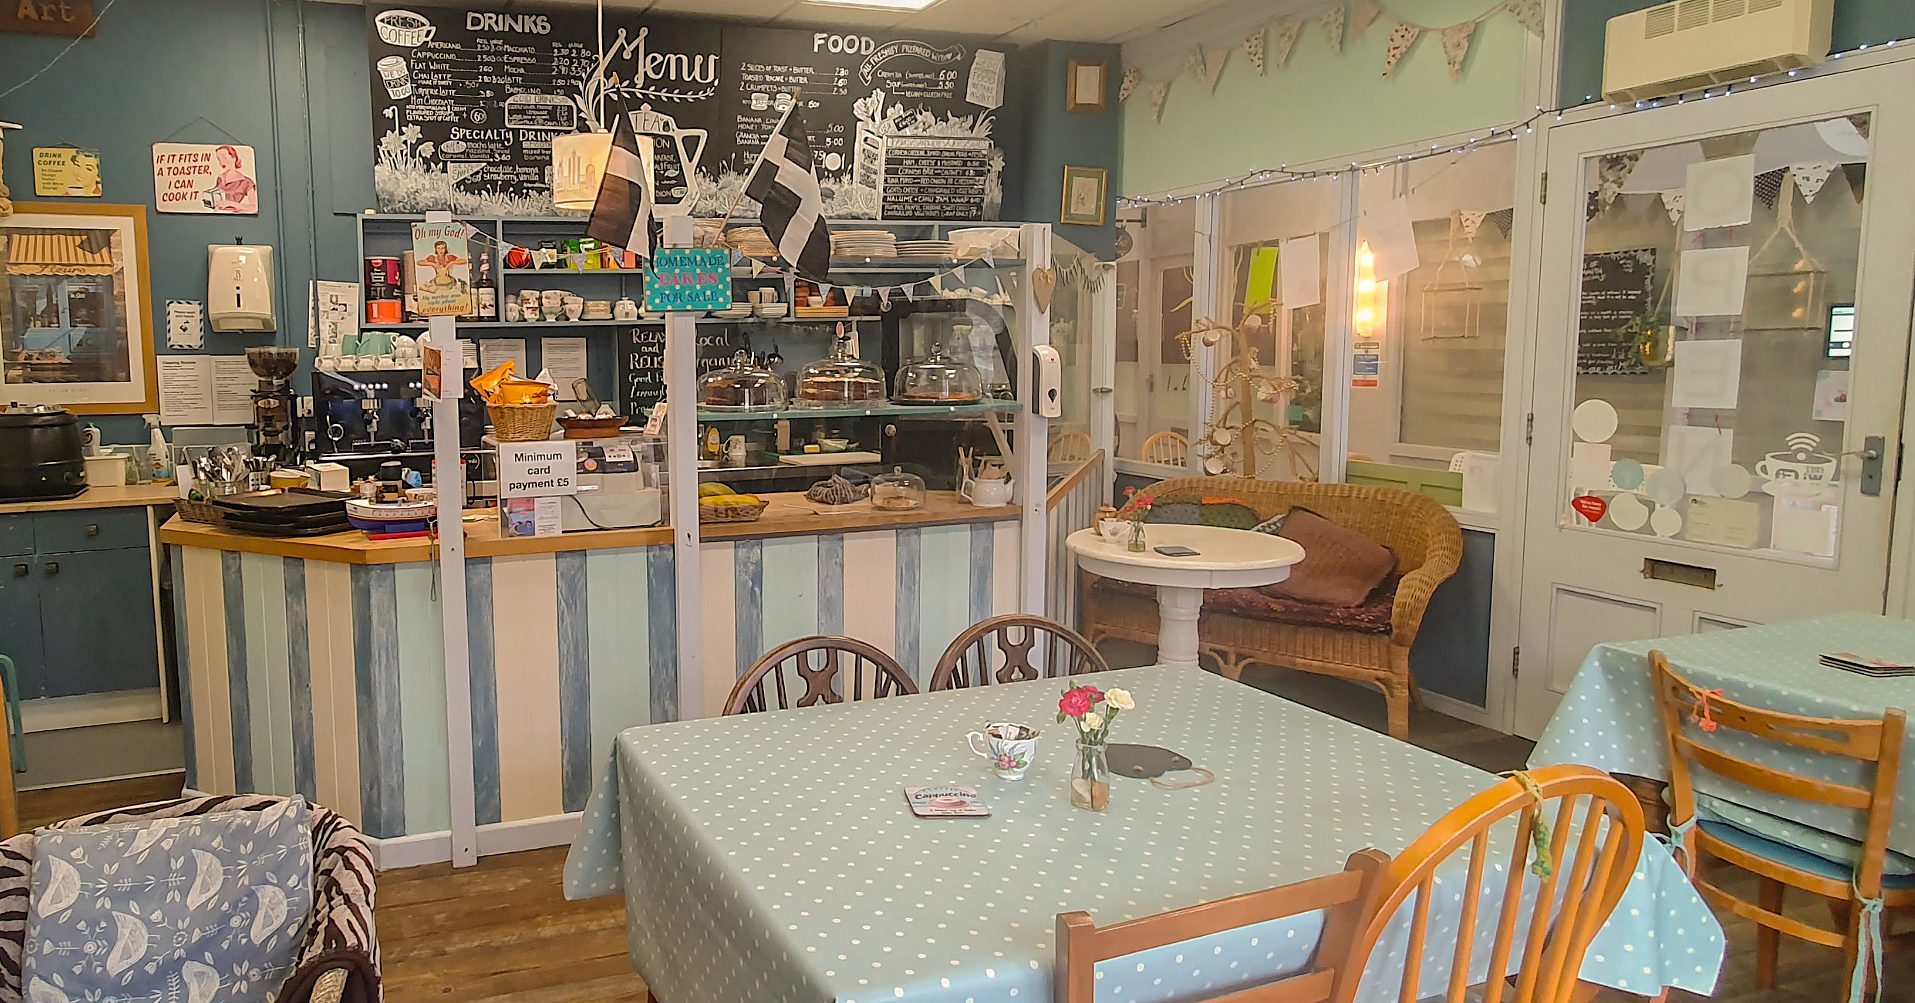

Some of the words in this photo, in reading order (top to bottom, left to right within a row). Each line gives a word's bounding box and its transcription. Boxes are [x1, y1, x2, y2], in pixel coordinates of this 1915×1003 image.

[17, 0, 76, 22] Art
[384, 15, 422, 29] FRESH
[466, 12, 551, 35] DRINKS
[380, 26, 424, 46] COFFEE
[427, 41, 461, 50] AMERICANO
[813, 33, 875, 55] FOOD
[411, 49, 456, 61] CAPPUCCINO
[503, 54, 537, 64] ESPRESSO
[601, 26, 720, 91] Menu
[411, 60, 427, 70] FLAT
[428, 61, 450, 71] WHITE
[412, 70, 430, 80] CHAI
[431, 71, 452, 81] LATTE
[385, 75, 410, 89] DRINKS
[439, 86, 457, 96] LATTE
[450, 127, 513, 146] SPECIALTY
[156, 154, 165, 164] IF
[167, 154, 176, 163] IT
[178, 153, 199, 163] FITS
[200, 153, 211, 162] IN
[157, 167, 164, 177] A
[167, 164, 212, 176] TOASTER,
[174, 179, 194, 189] CAN
[162, 192, 188, 202] COOK
[190, 191, 199, 201] IT
[414, 227, 426, 240] Oh
[428, 228, 442, 239] my
[444, 225, 464, 239] God!
[659, 271, 718, 287] CAKES
[660, 292, 683, 303] FOR
[687, 290, 719, 302] SALE
[422, 303, 469, 314] everything!
[514, 452, 563, 462] Minimum
[527, 465, 551, 475] card
[509, 479, 554, 491] payment
[557, 477, 569, 487] £5
[914, 791, 977, 800] Cappuccino
